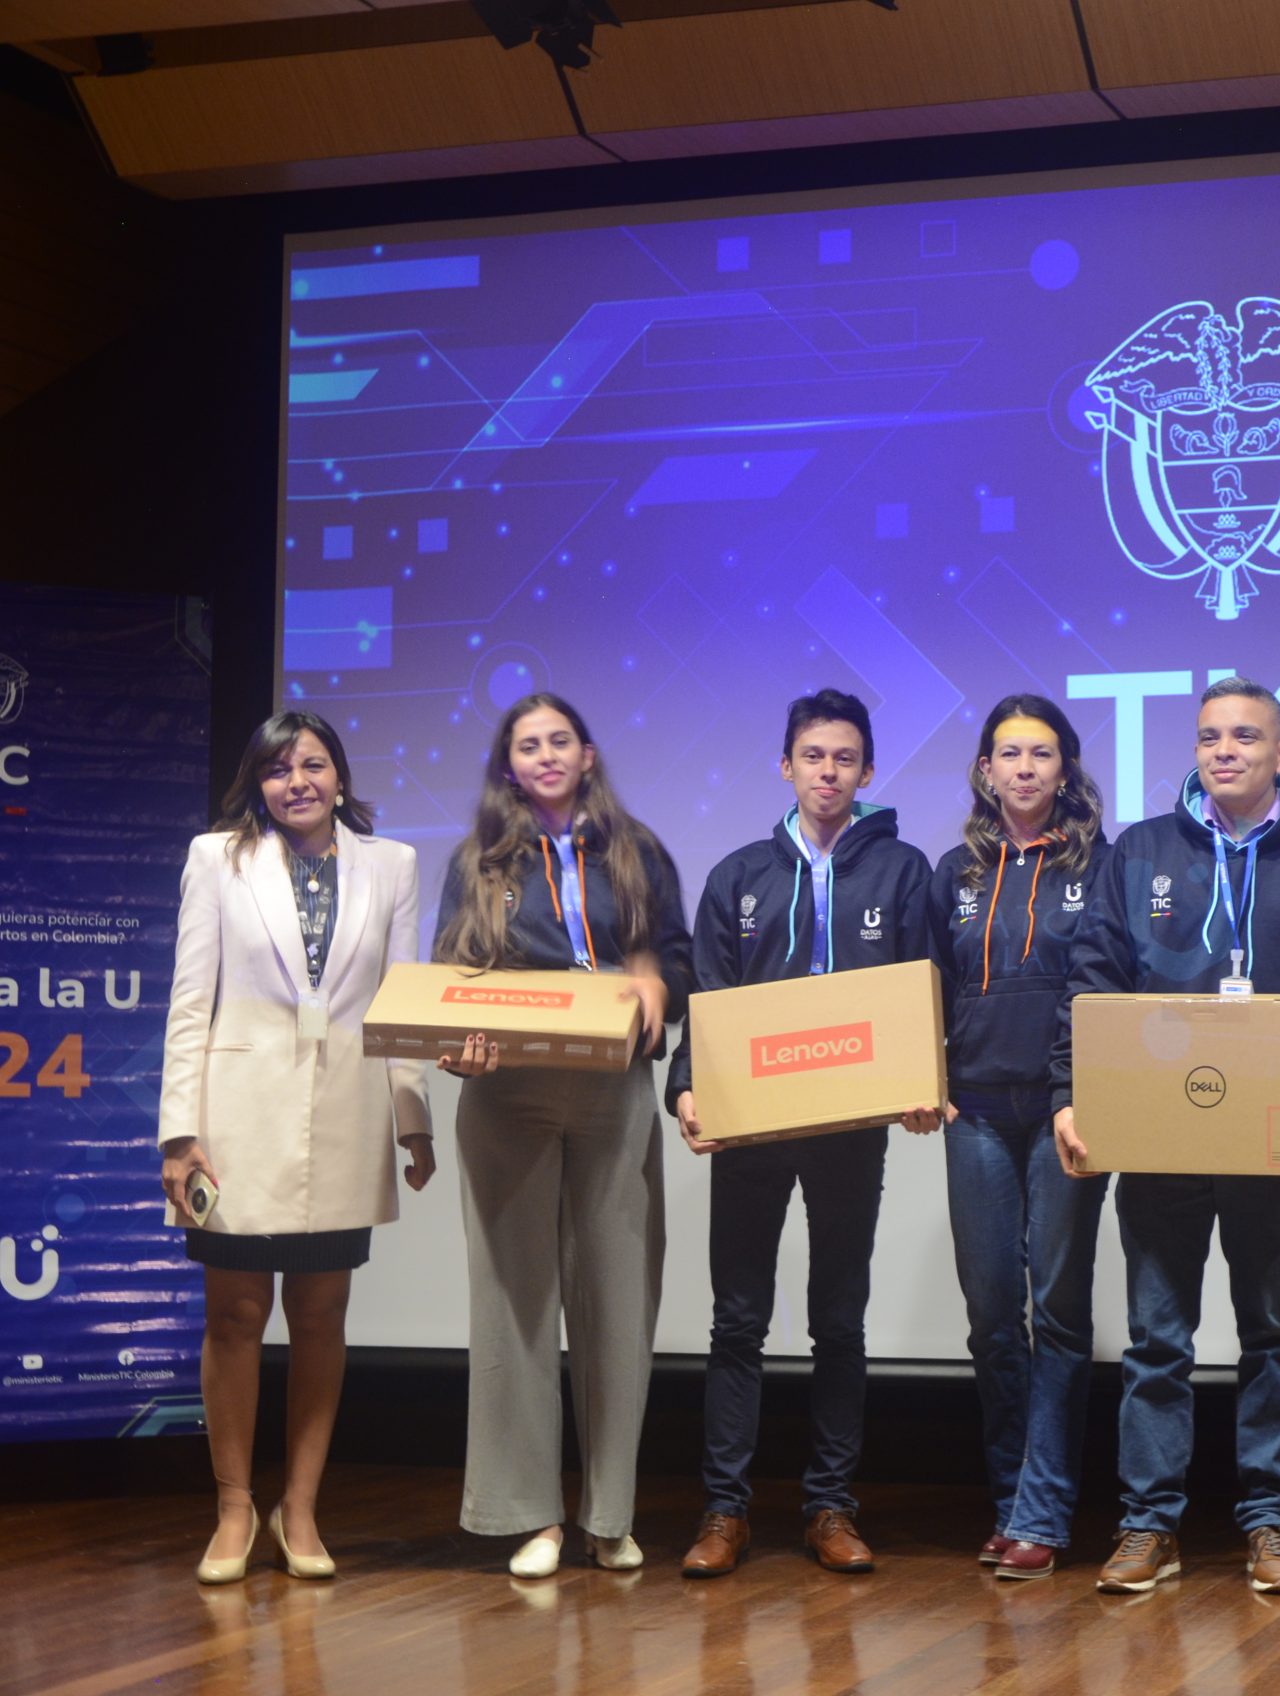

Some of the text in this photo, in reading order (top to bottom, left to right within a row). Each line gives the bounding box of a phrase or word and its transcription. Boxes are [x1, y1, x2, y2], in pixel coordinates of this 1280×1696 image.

[958, 903, 978, 916] TIC
[1150, 898, 1172, 910] TIC
[48, 912, 112, 927] potenciar
[116, 918, 140, 928] con
[740, 918, 756, 929] TIC
[31, 931, 48, 942] en
[52, 930, 126, 944] Colombia?
[39, 967, 84, 1008] la
[105, 969, 140, 1009] U
[453, 989, 562, 1005] Lenovo
[761, 1037, 862, 1067] Lenovo
[1190, 1081, 1222, 1093] DELL
[3, 1375, 64, 1387] @ministeriotic
